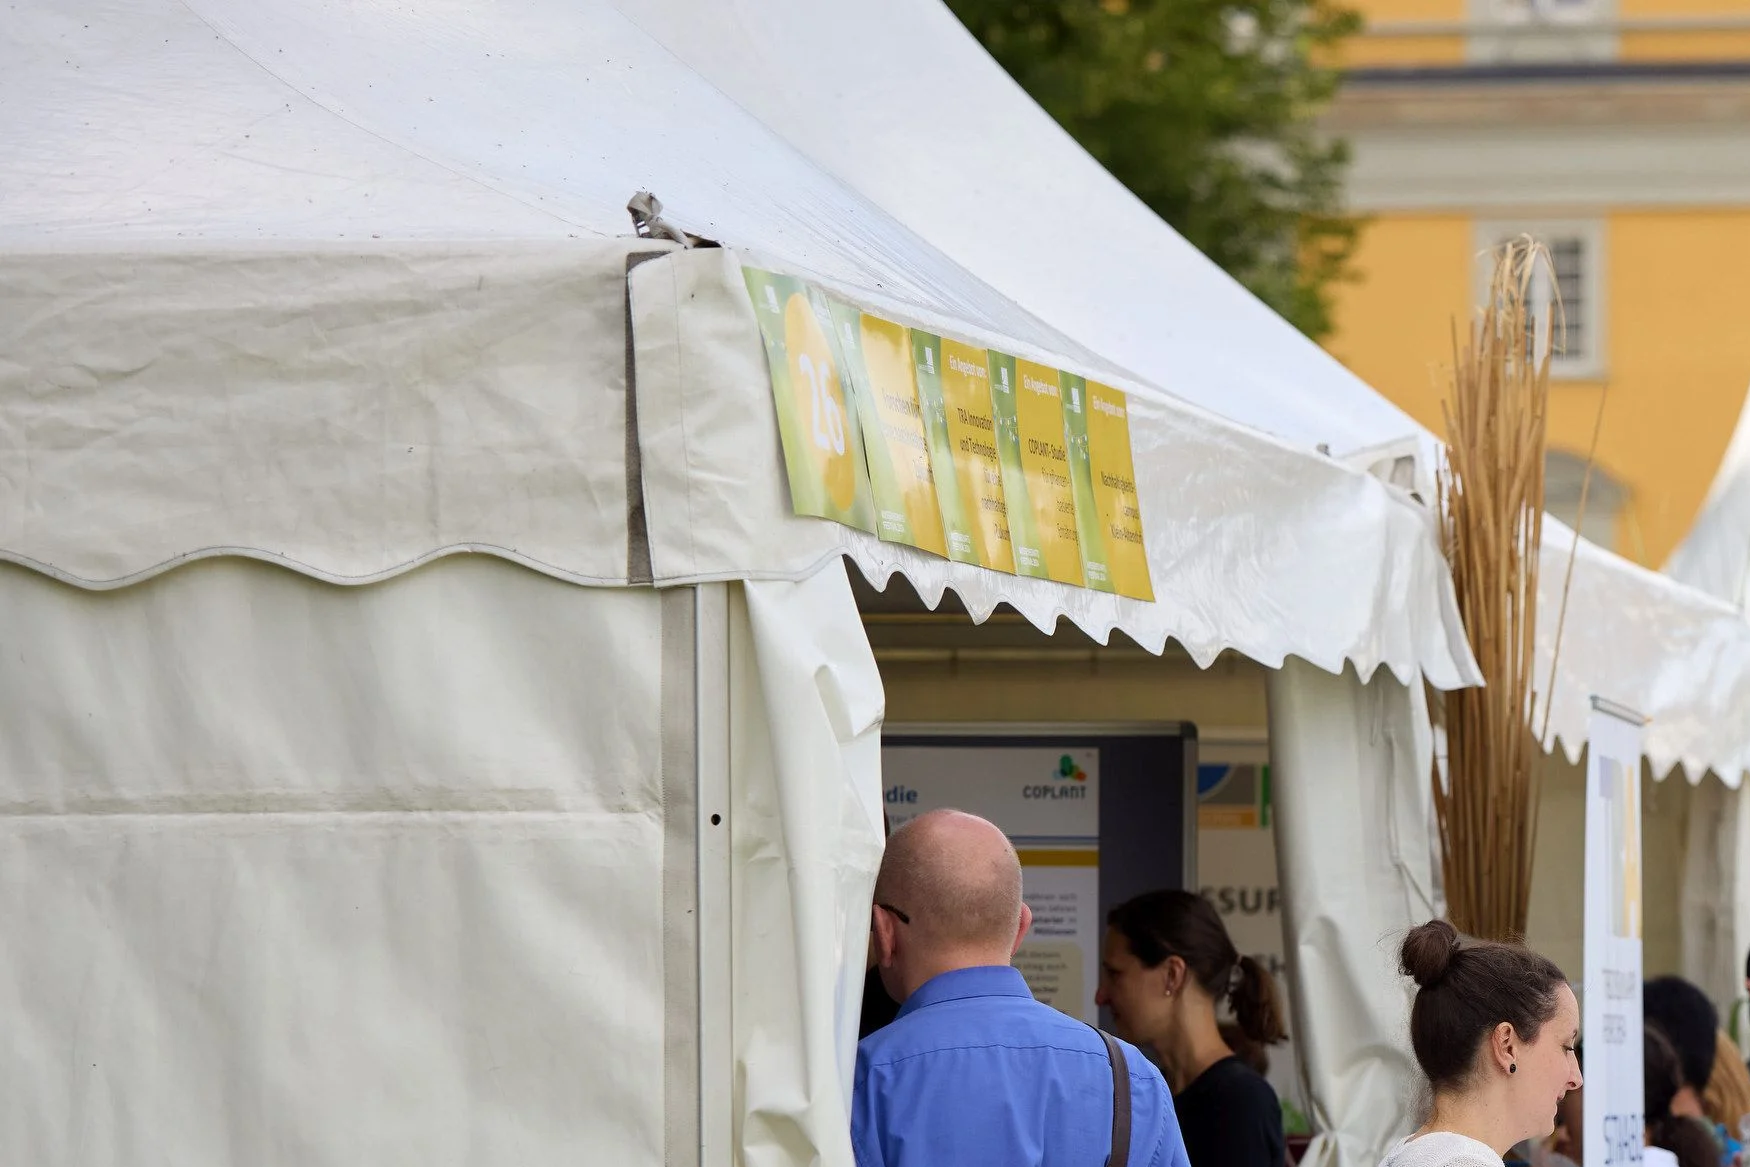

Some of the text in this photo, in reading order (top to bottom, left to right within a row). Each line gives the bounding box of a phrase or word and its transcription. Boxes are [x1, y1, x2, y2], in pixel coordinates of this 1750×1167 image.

[798, 353, 845, 455] 26
[957, 408, 993, 432] TRA Innovation
[960, 436, 997, 462] und Technologie
[1022, 785, 1086, 799] COPLANT
